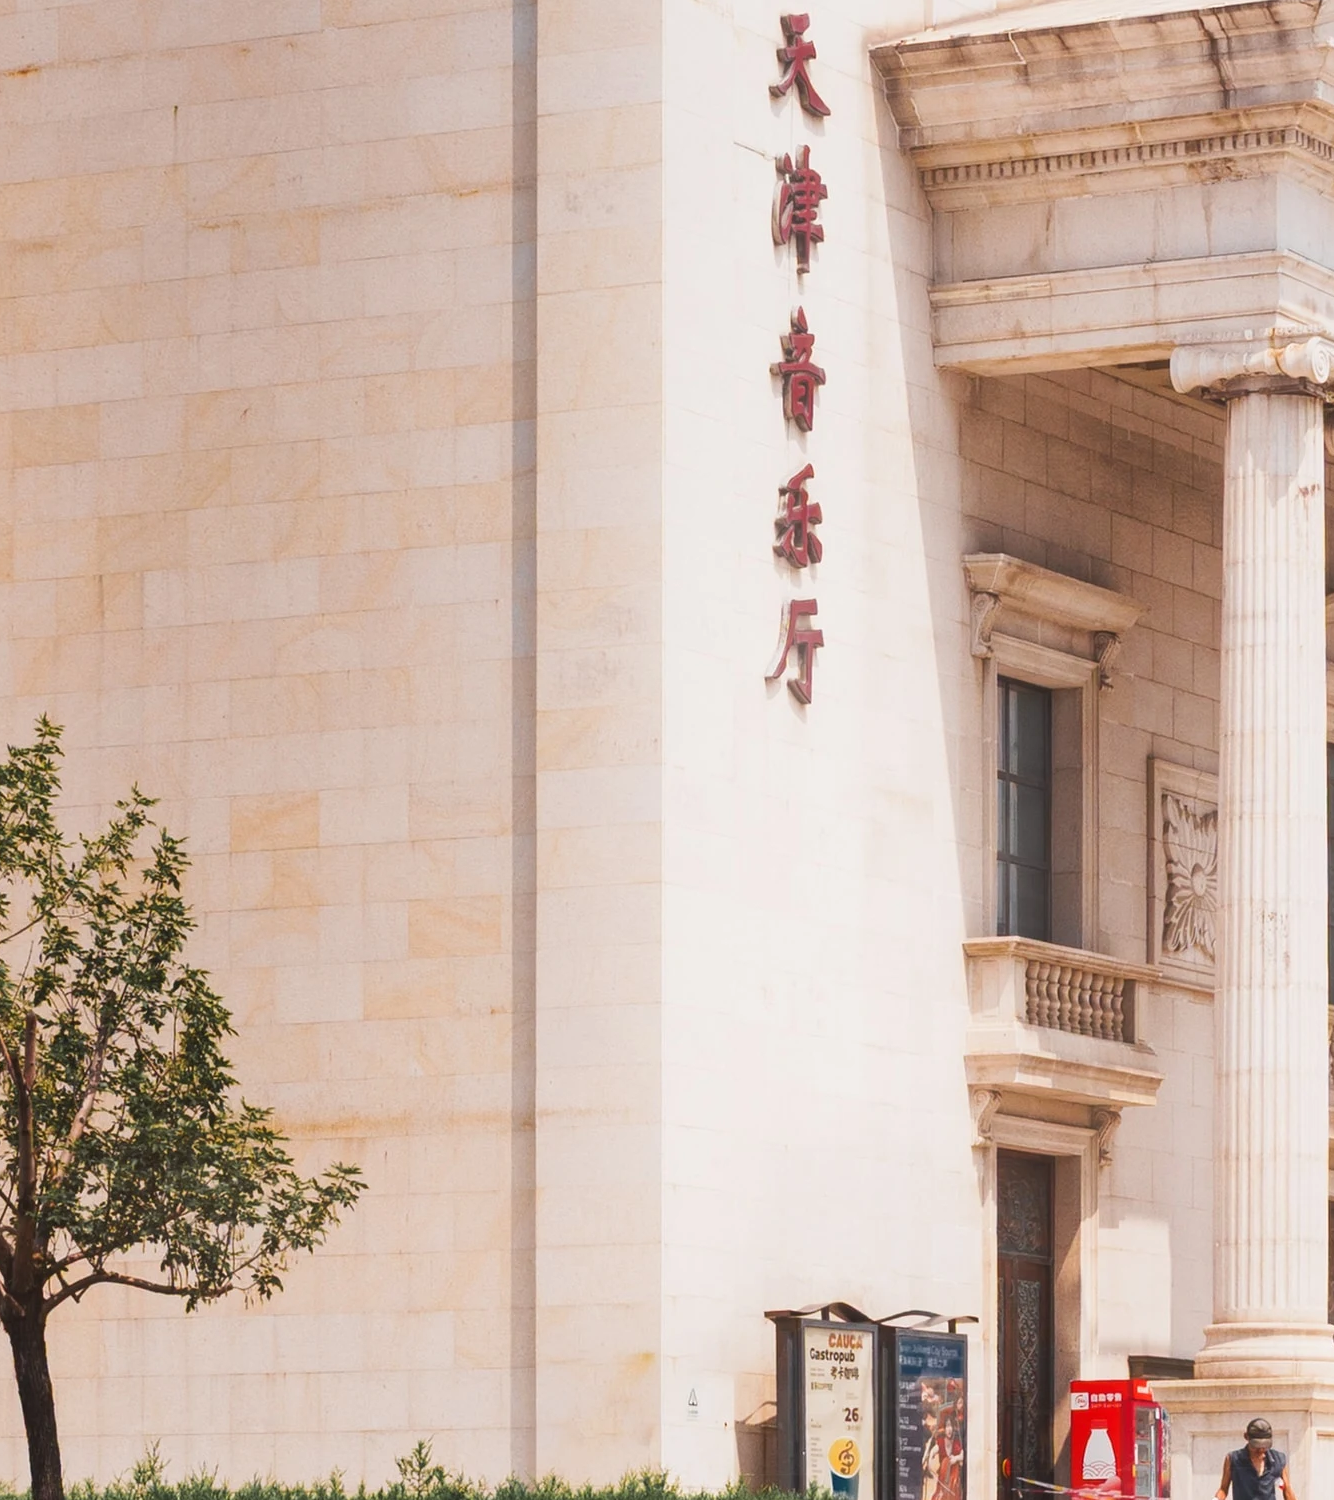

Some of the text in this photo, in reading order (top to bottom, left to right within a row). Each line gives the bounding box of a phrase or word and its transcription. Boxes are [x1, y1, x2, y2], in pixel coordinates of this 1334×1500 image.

[765, 12, 832, 705] 天津音乐厅
[810, 1348, 855, 1364] Gastropub
[844, 1407, 859, 1422] 26
